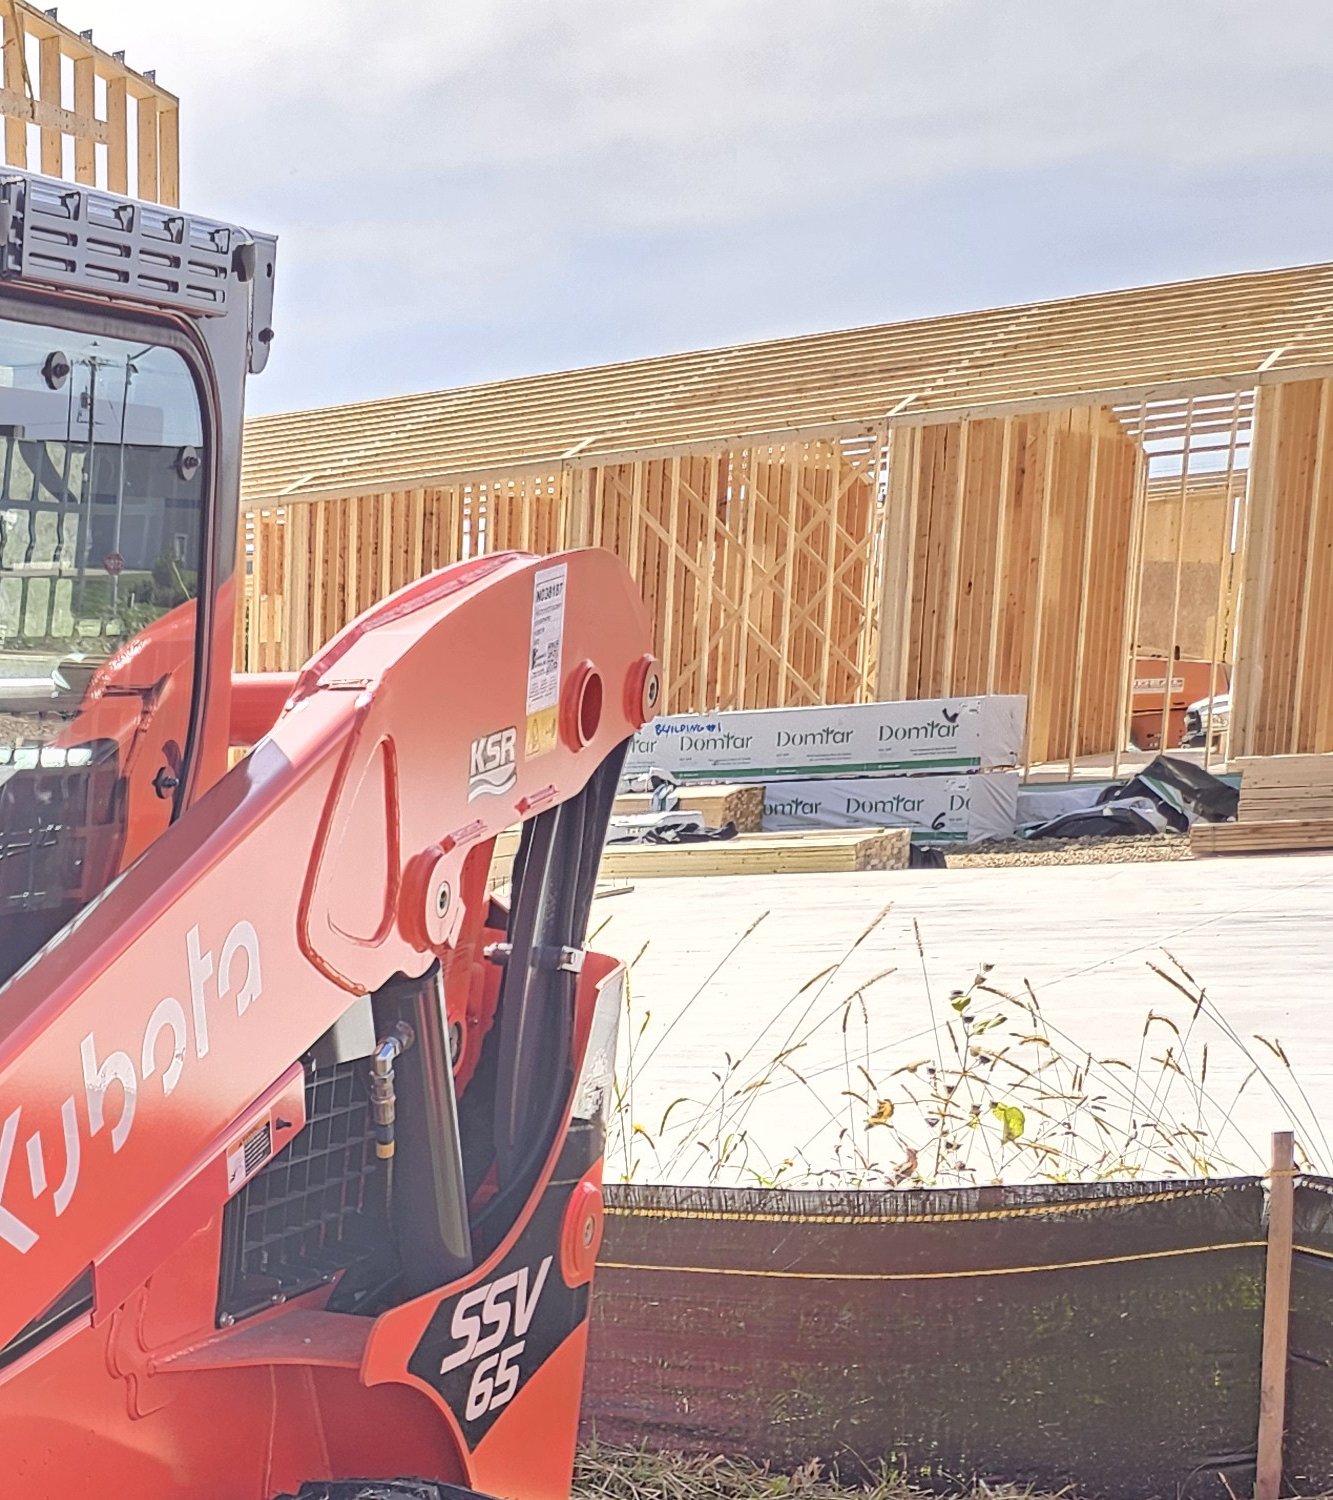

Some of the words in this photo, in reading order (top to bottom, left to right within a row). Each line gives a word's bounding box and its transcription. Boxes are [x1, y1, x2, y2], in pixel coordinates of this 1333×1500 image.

[655, 723, 704, 736] BUILDING
[777, 727, 854, 748] Domtar
[878, 721, 960, 742] Domtar
[470, 728, 517, 775] KSR
[630, 736, 658, 754] tar
[680, 732, 753, 752] Domtar
[763, 797, 822, 817] omtar
[846, 794, 925, 814] Domtar
[441, 1255, 555, 1375] SSV
[466, 1340, 525, 1424] 65
